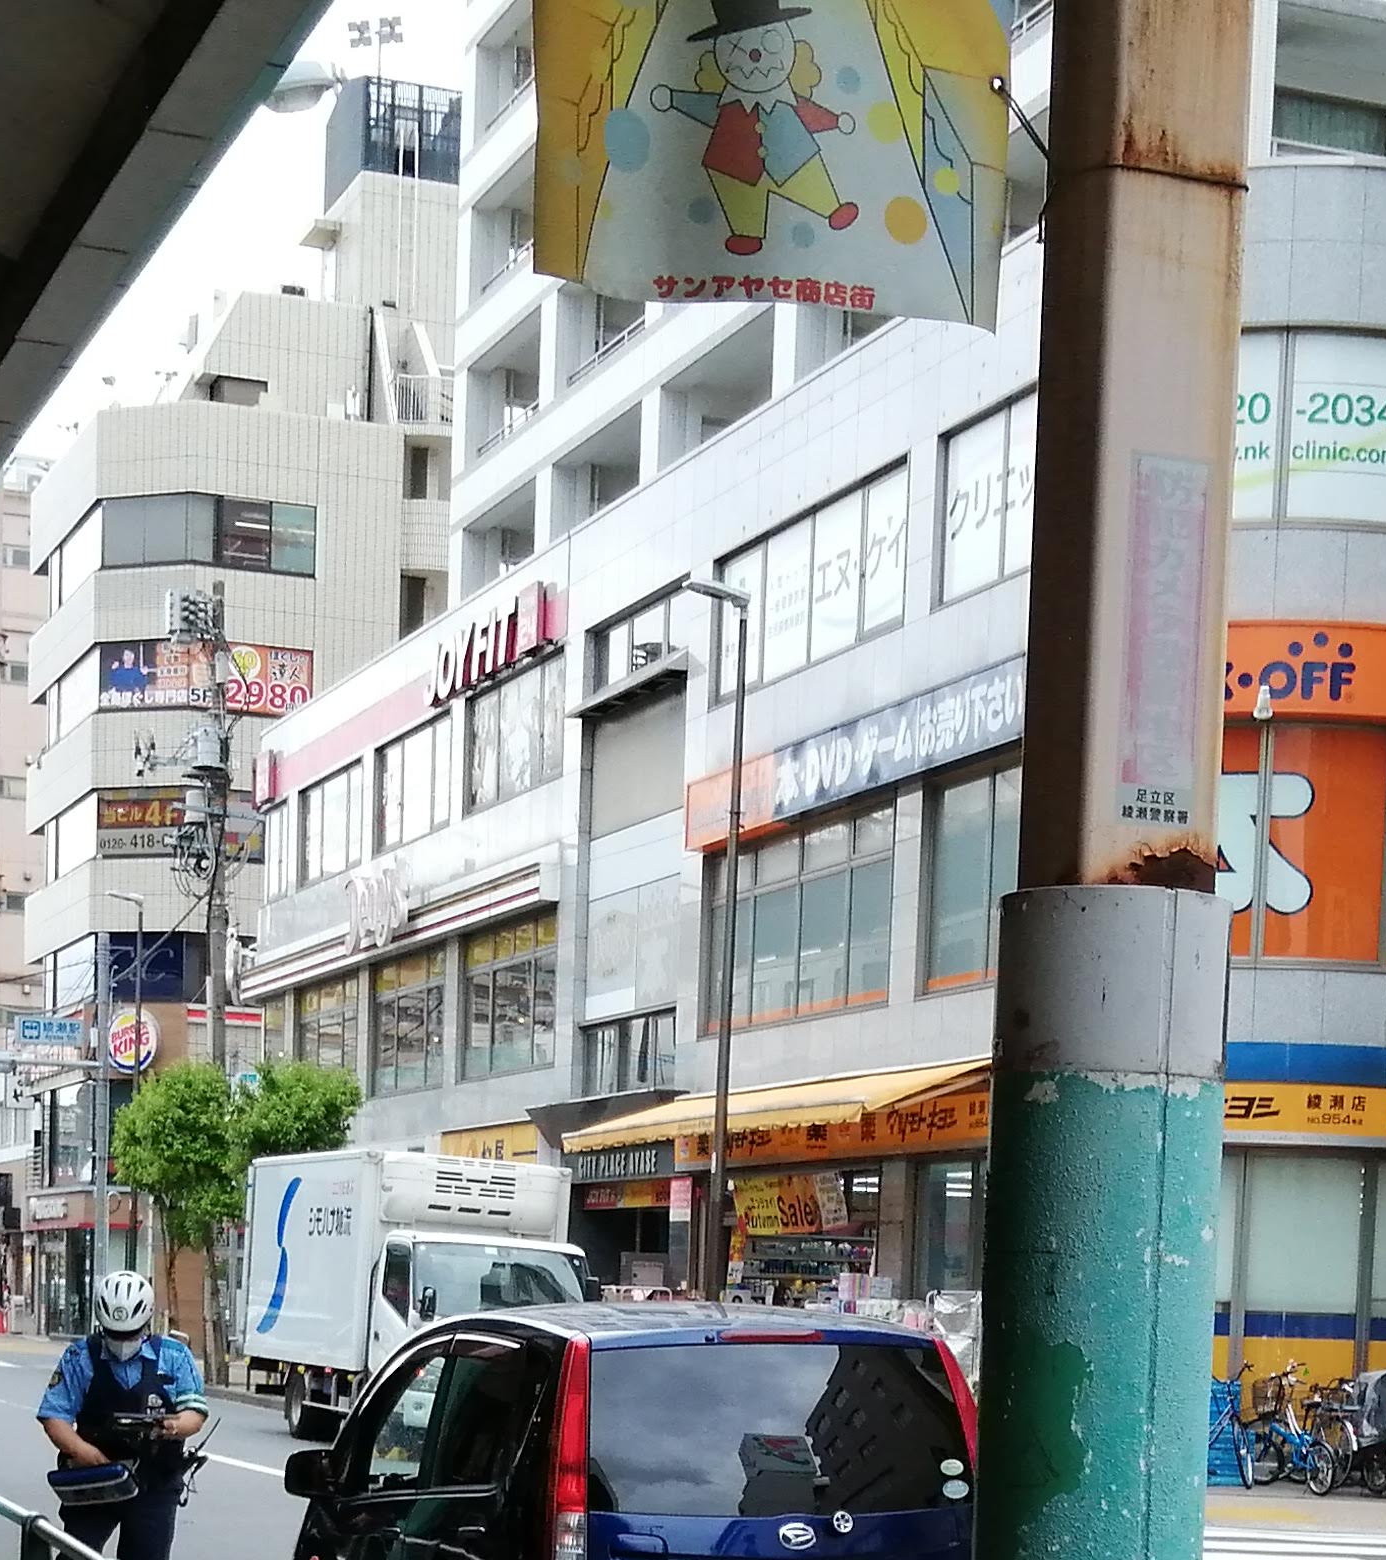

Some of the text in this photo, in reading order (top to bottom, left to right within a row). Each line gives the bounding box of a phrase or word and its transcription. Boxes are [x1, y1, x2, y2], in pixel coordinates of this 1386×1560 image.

[652, 274, 876, 311] サンアヤセ商店街
[1135, 788, 1177, 807] 足立区
[1120, 805, 1190, 826] 綾瀬警察署
[113, 1031, 150, 1058] KING
[1224, 1095, 1281, 1120] ヨシ
[1306, 1092, 1367, 1113] 綾瀬店
[577, 1148, 657, 1180] CITY PLACE AYASE
[776, 1194, 816, 1228] Sale
